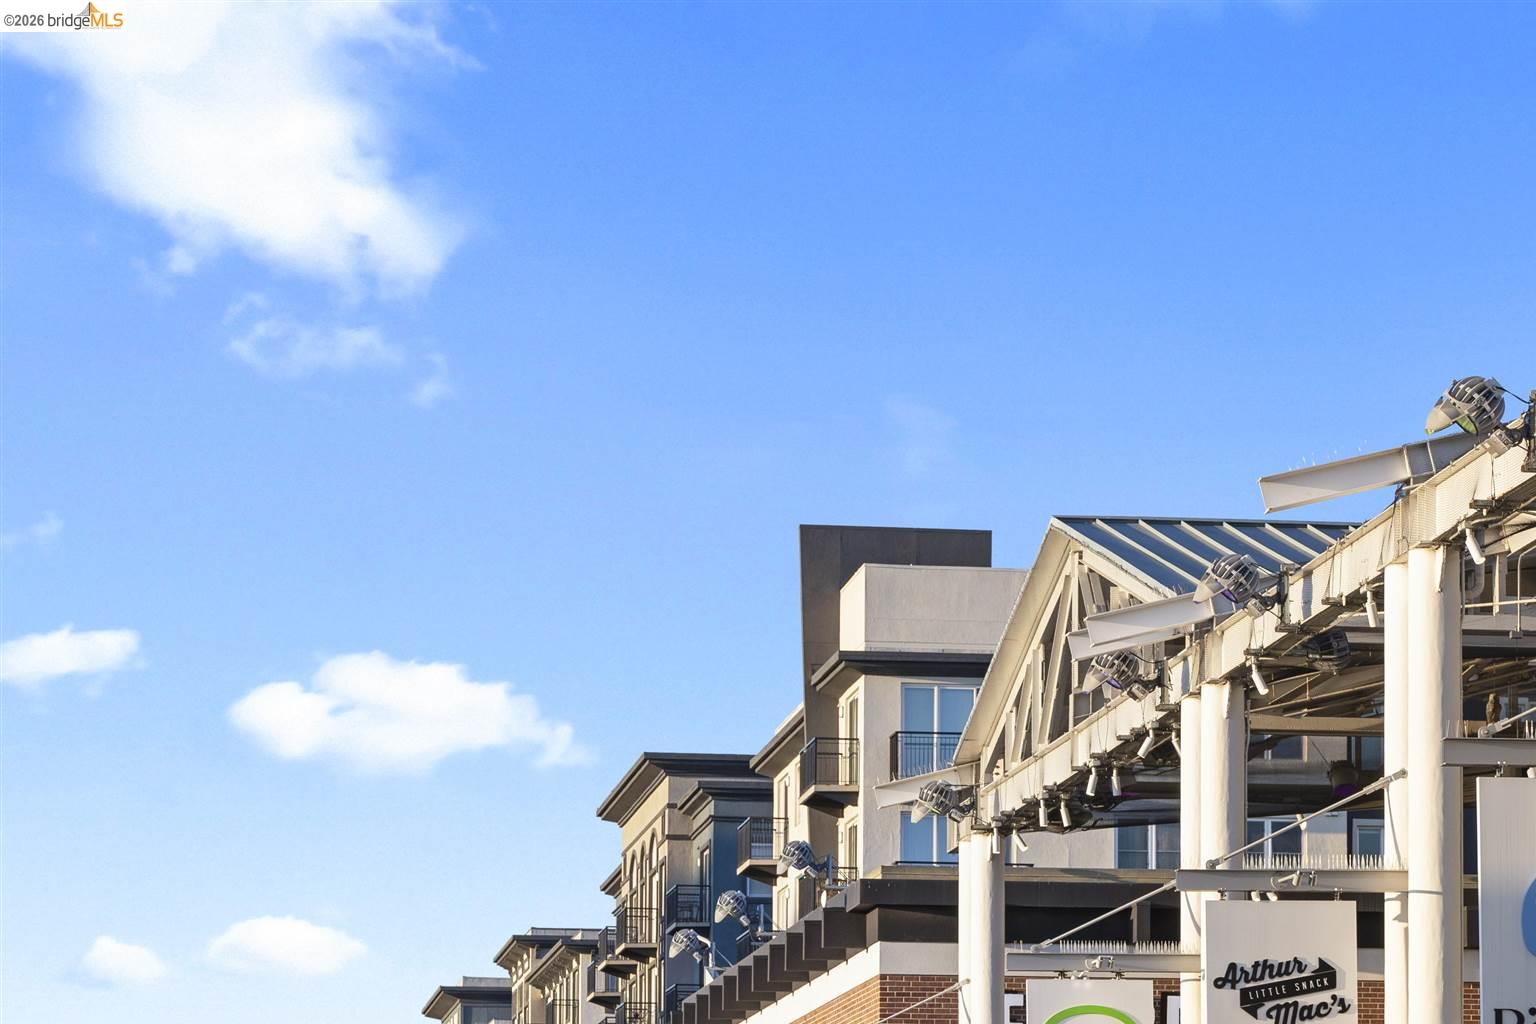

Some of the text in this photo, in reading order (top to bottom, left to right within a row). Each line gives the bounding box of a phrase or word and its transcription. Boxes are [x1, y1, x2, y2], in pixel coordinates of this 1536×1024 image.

[1213, 956, 1308, 990] Arthur
[1248, 977, 1330, 1000] LITTLE SNACK
